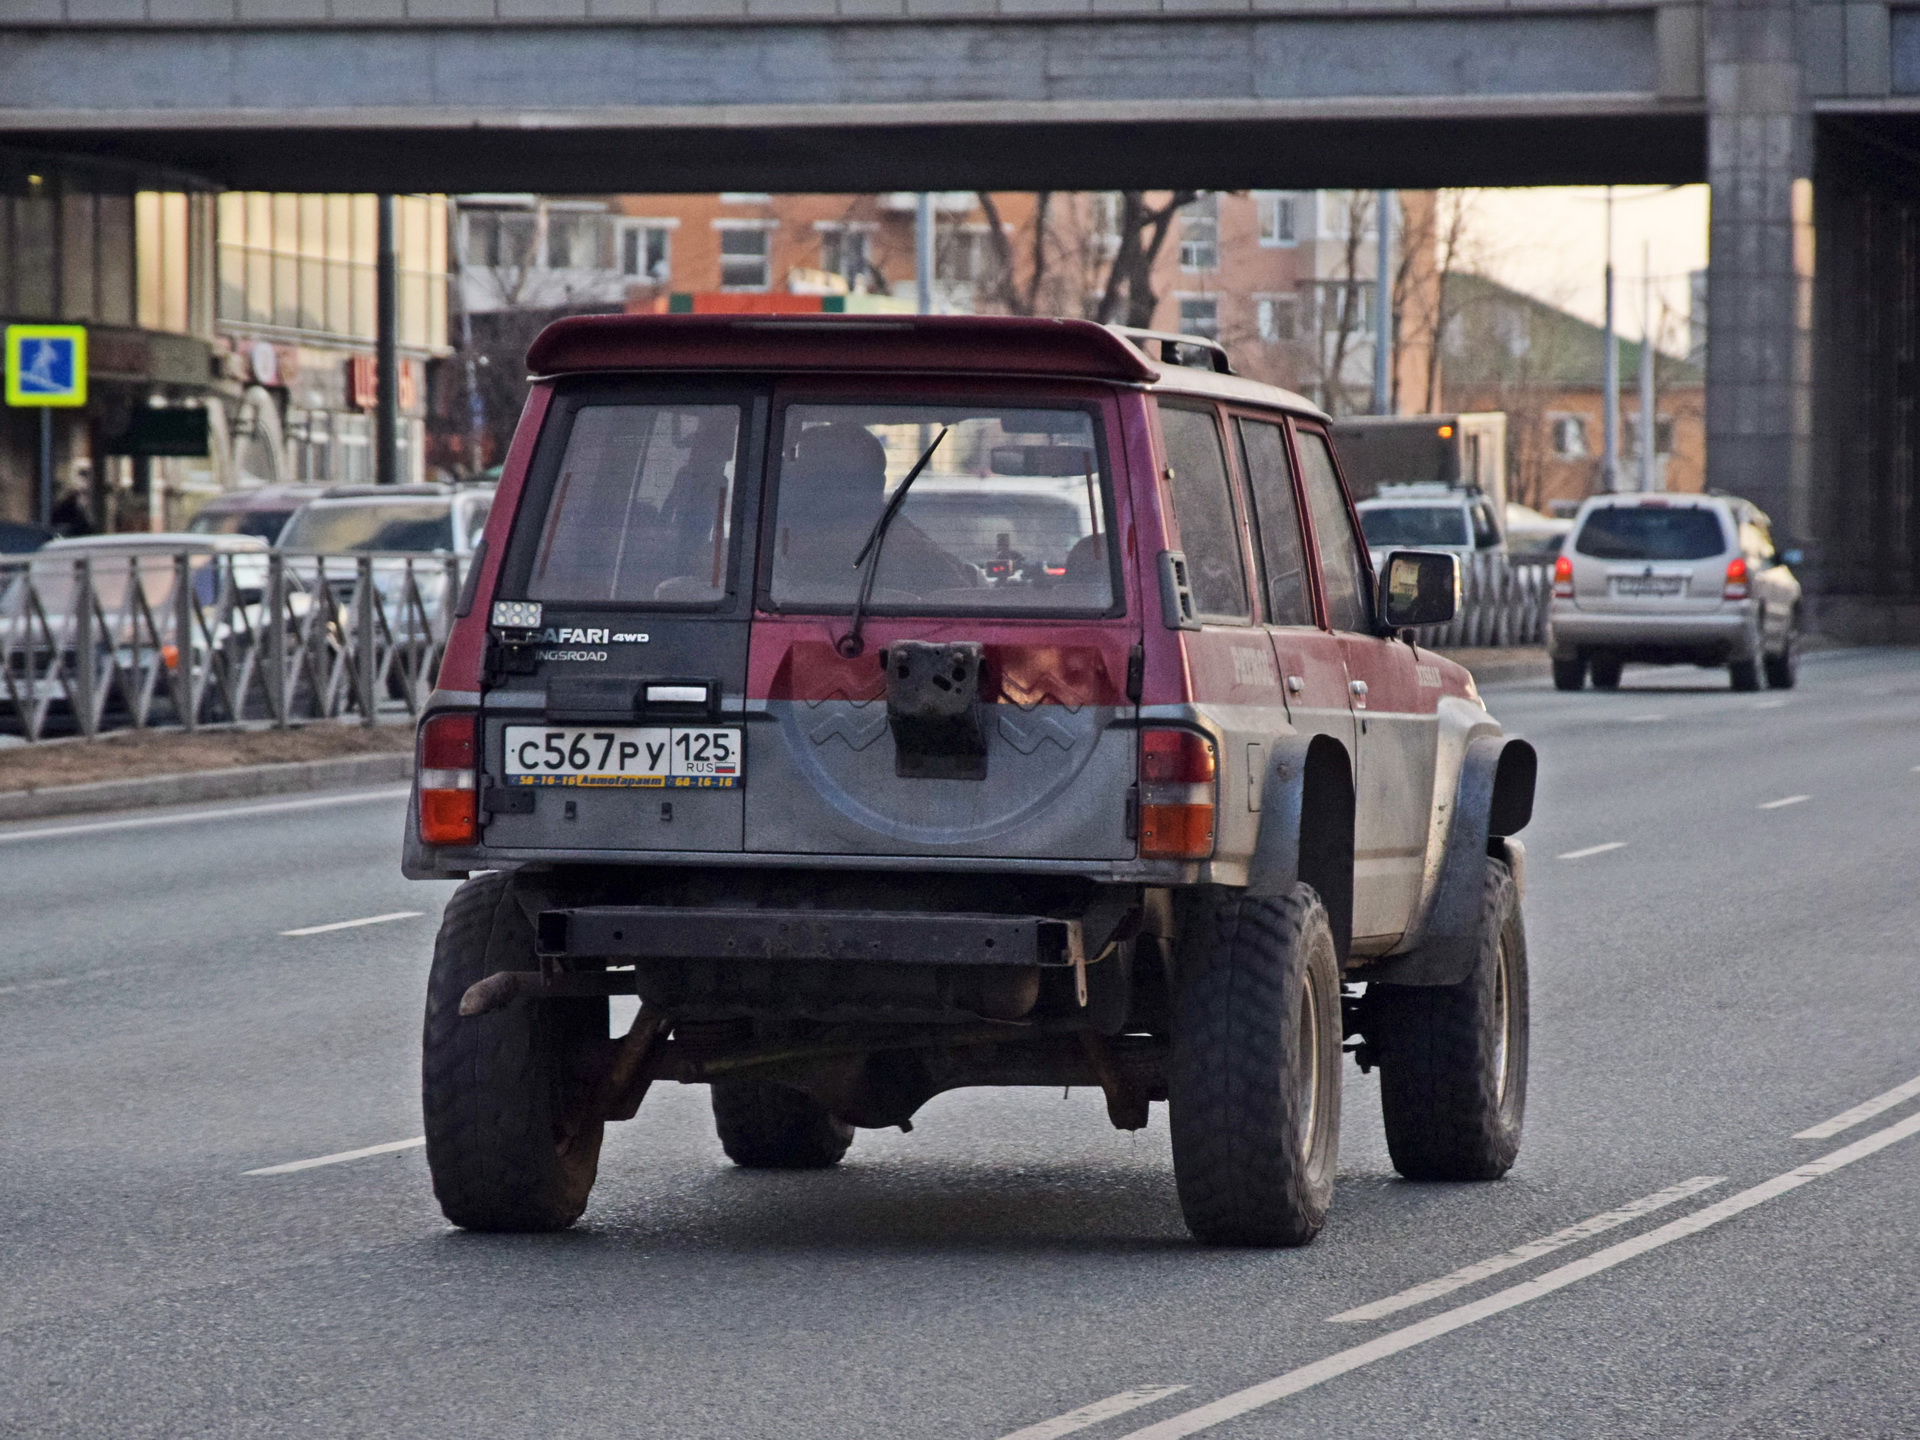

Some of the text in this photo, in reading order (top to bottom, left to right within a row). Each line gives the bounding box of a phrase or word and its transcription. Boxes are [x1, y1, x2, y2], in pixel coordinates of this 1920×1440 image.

[612, 633, 650, 643] 4WD
[535, 650, 608, 662] INGSROAD
[675, 733, 730, 762] 125
[686, 762, 714, 773] RUS
